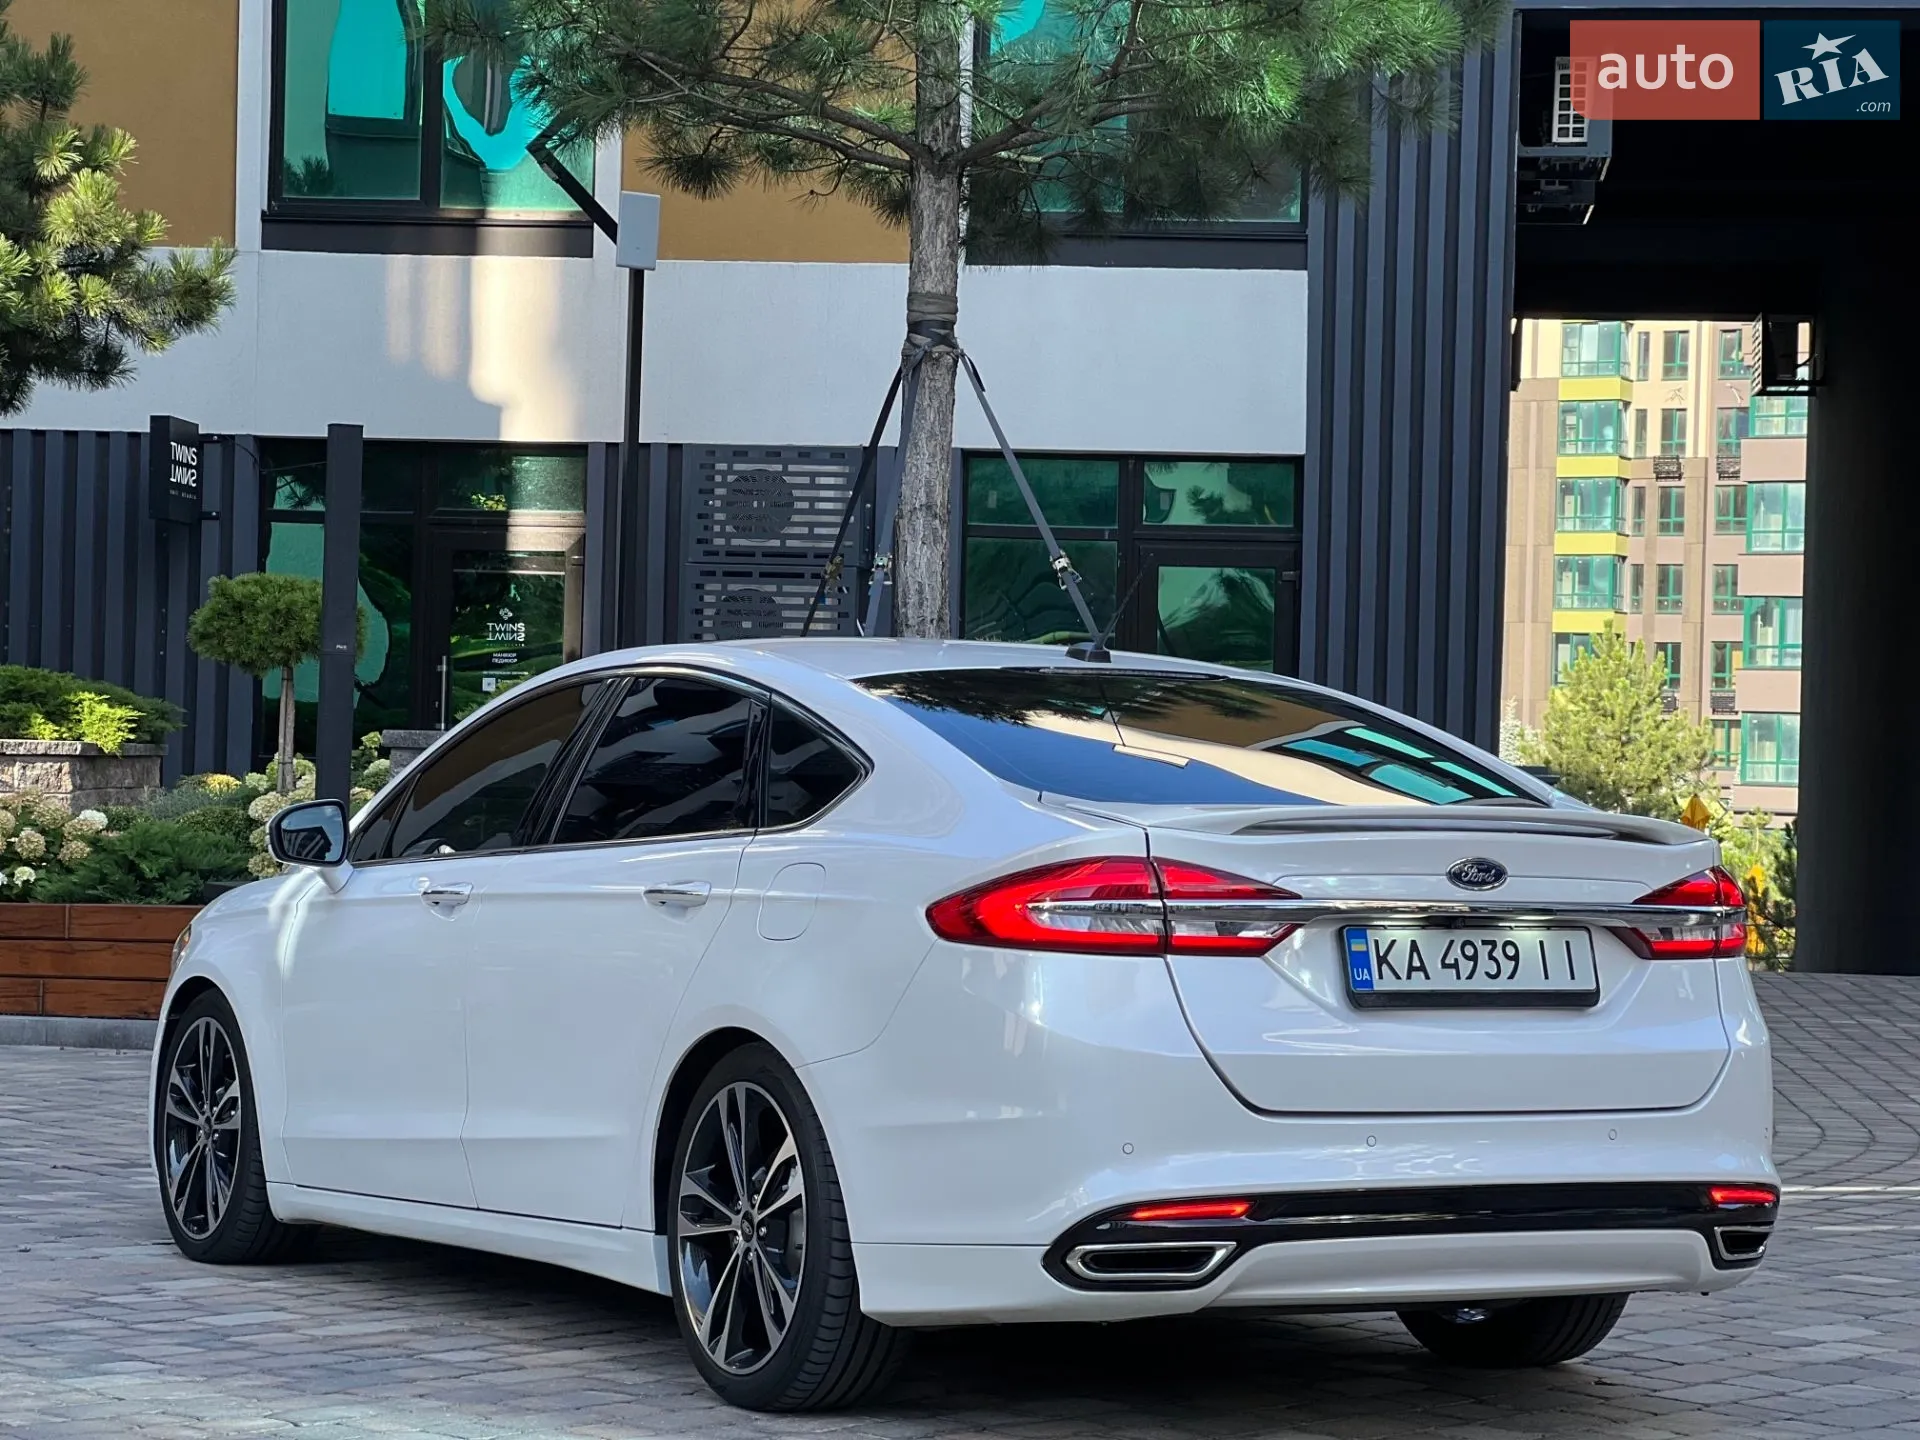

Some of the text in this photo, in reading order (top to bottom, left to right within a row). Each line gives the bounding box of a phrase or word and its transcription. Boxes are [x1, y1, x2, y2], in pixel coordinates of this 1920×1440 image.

[170, 441, 198, 466] TWINS
[486, 622, 526, 632] TWINS
[1461, 863, 1496, 882] Ford
[1373, 939, 1431, 981] KA
[1440, 939, 1520, 981] 4939
[1353, 967, 1371, 981] UA
